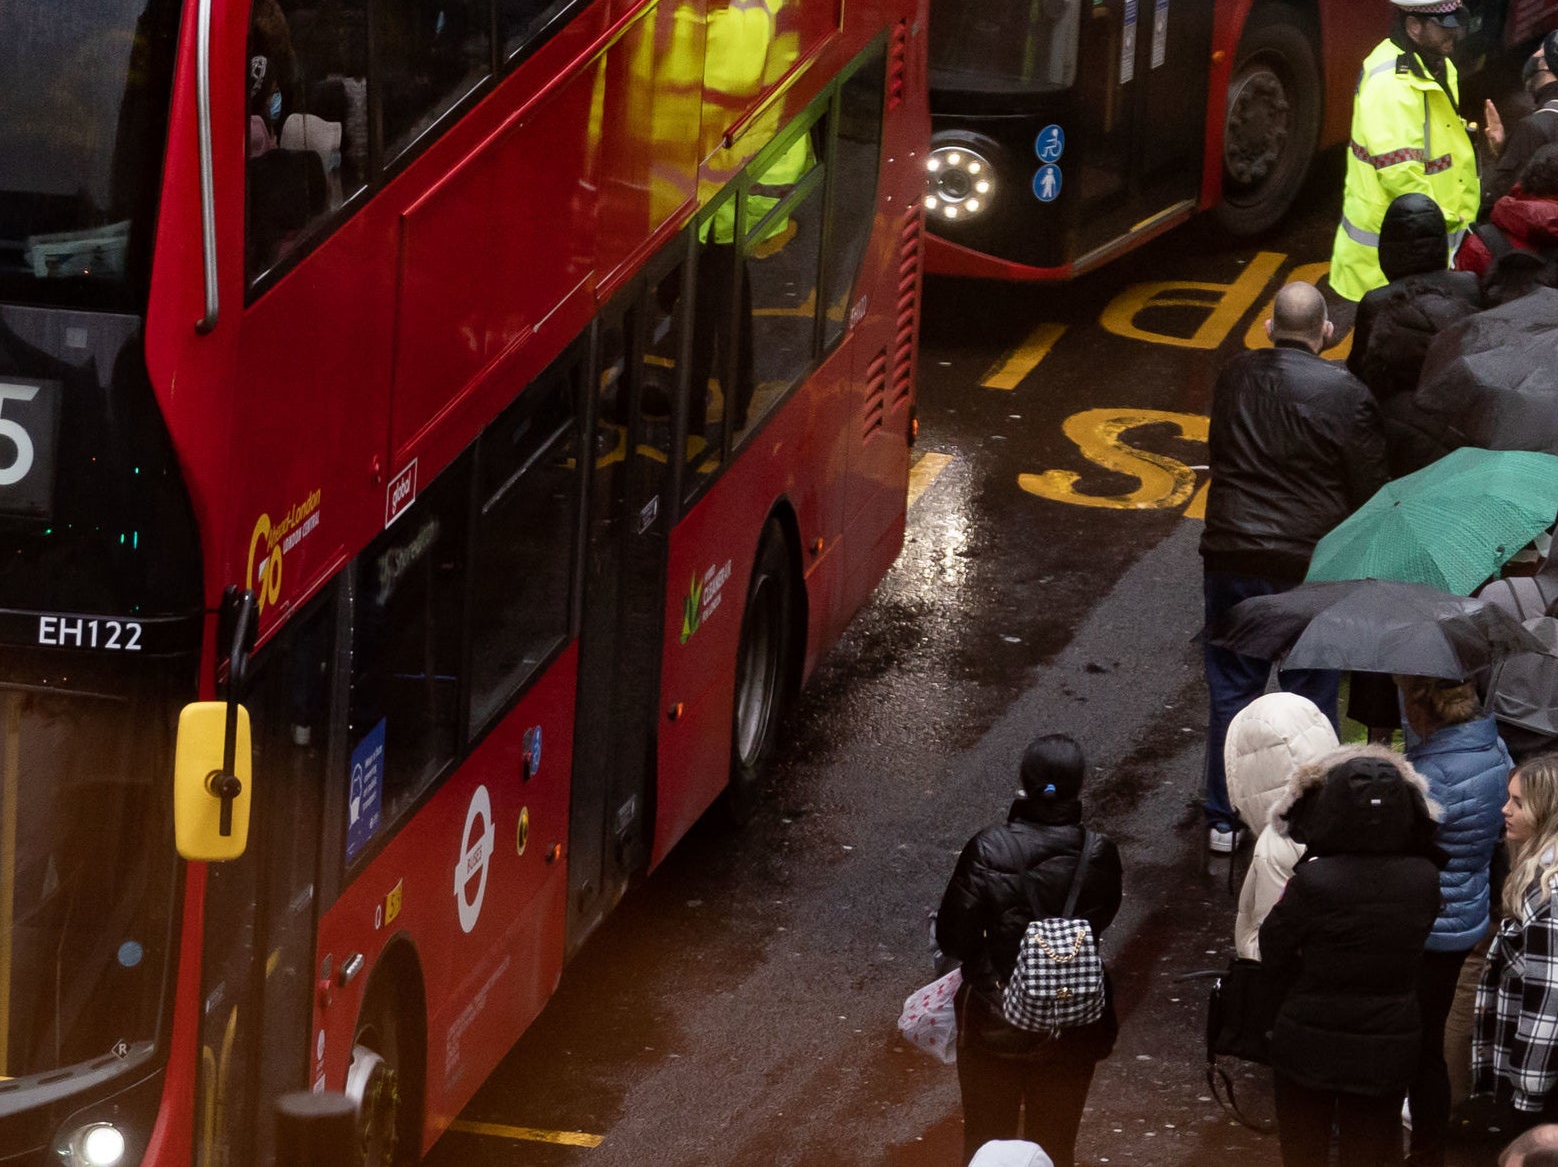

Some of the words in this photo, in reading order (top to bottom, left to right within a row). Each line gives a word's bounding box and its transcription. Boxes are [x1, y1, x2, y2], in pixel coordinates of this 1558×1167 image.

[391, 469, 412, 516] global
[38, 615, 143, 651] EH122
[118, 1042, 128, 1055] R
